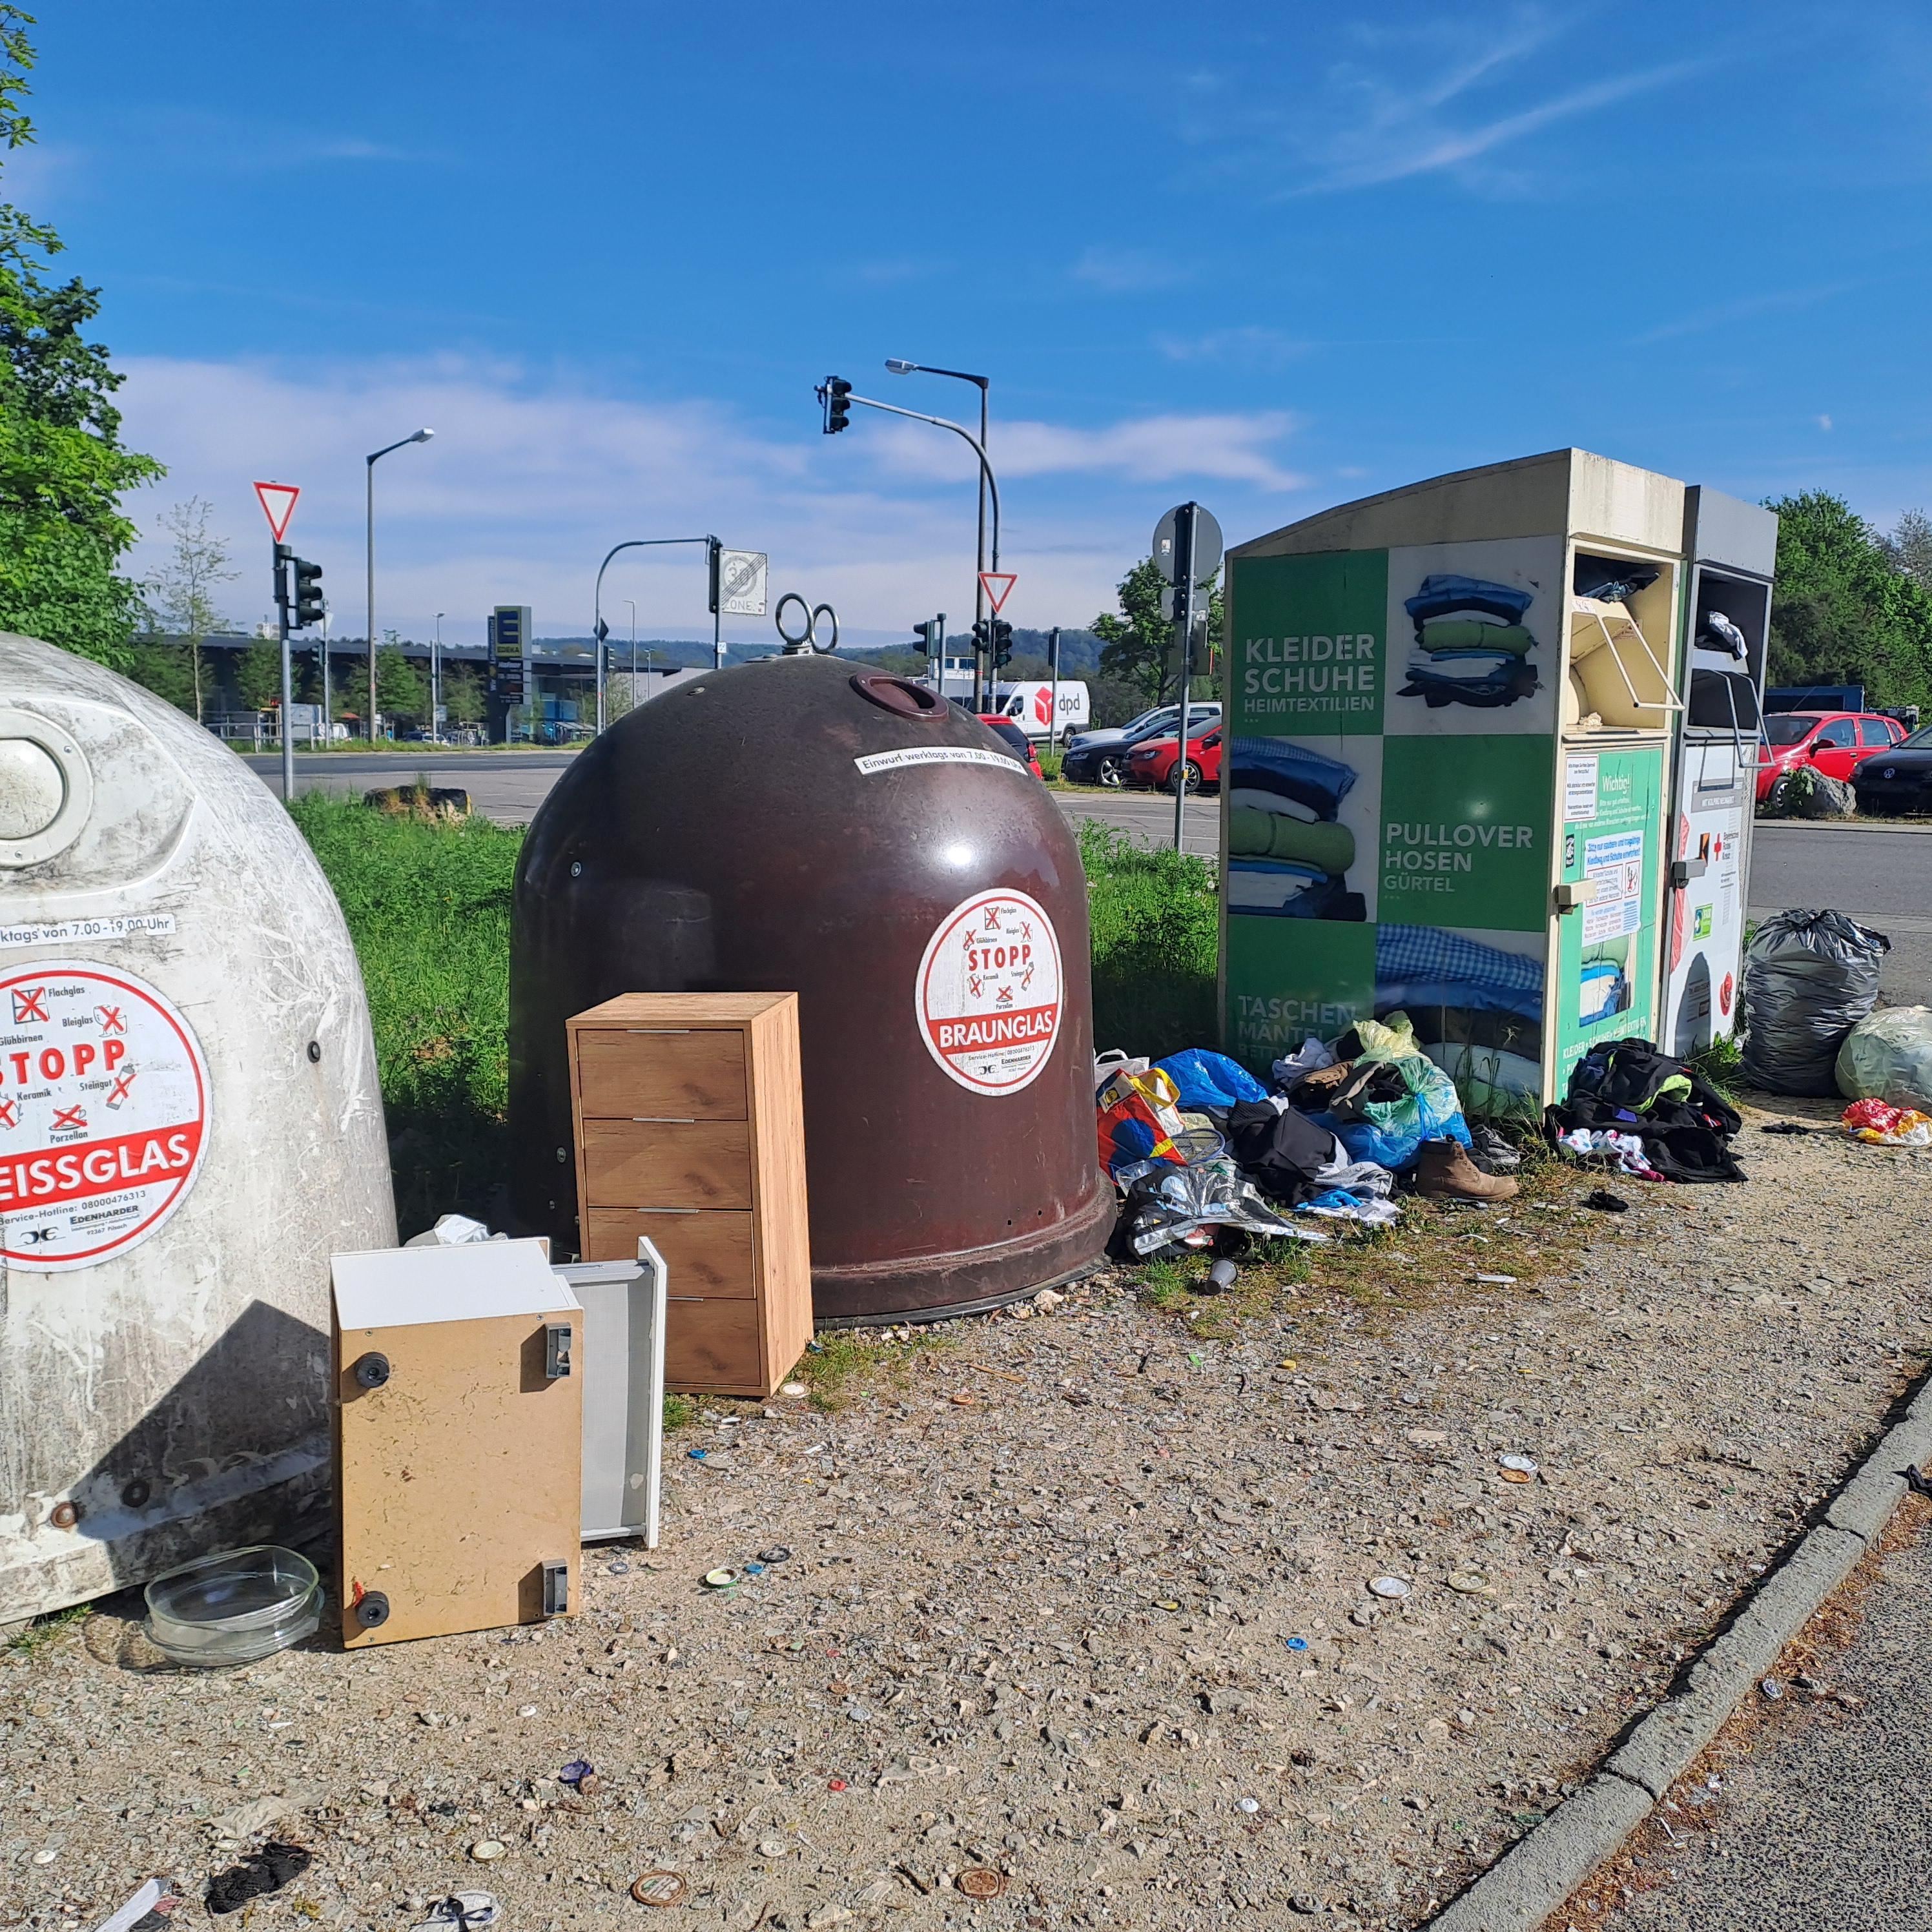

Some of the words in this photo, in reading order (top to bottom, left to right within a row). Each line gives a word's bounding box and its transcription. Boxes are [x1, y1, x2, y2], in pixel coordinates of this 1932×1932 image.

[1246, 633, 1375, 663] KLEIDER
[1245, 665, 1375, 694] SCHUHE
[1059, 693, 1080, 715] dpd
[1244, 696, 1374, 713] HEIMTEXTILIEN
[862, 752, 902, 769] Einwurf
[905, 750, 947, 761] werktags
[1603, 774, 1630, 794] Wichtig!
[1386, 823, 1534, 848] PULLOVER
[1385, 850, 1472, 872] HOSEN
[1384, 872, 1455, 892] GÜRTEL
[43, 927, 68, 938] von
[148, 918, 170, 930] Uhr
[969, 944, 1031, 971] STOPP
[48, 985, 85, 998] Flachglas
[1238, 995, 1356, 1026] TASCHEN
[61, 1016, 94, 1028] Bleiglas
[940, 1010, 1053, 1048] BRAUNGLAS
[0, 1034, 43, 1046] Glühbirnen
[1563, 1041, 1585, 1059] KLEIDER
[0, 1039, 125, 1086] TOPP
[17, 1088, 52, 1101] Keramik
[79, 1079, 112, 1091] Steingut
[50, 1131, 88, 1144] Porzellan
[81, 1190, 146, 1210] 08000476313
[69, 1205, 139, 1225] EDENHARDER
